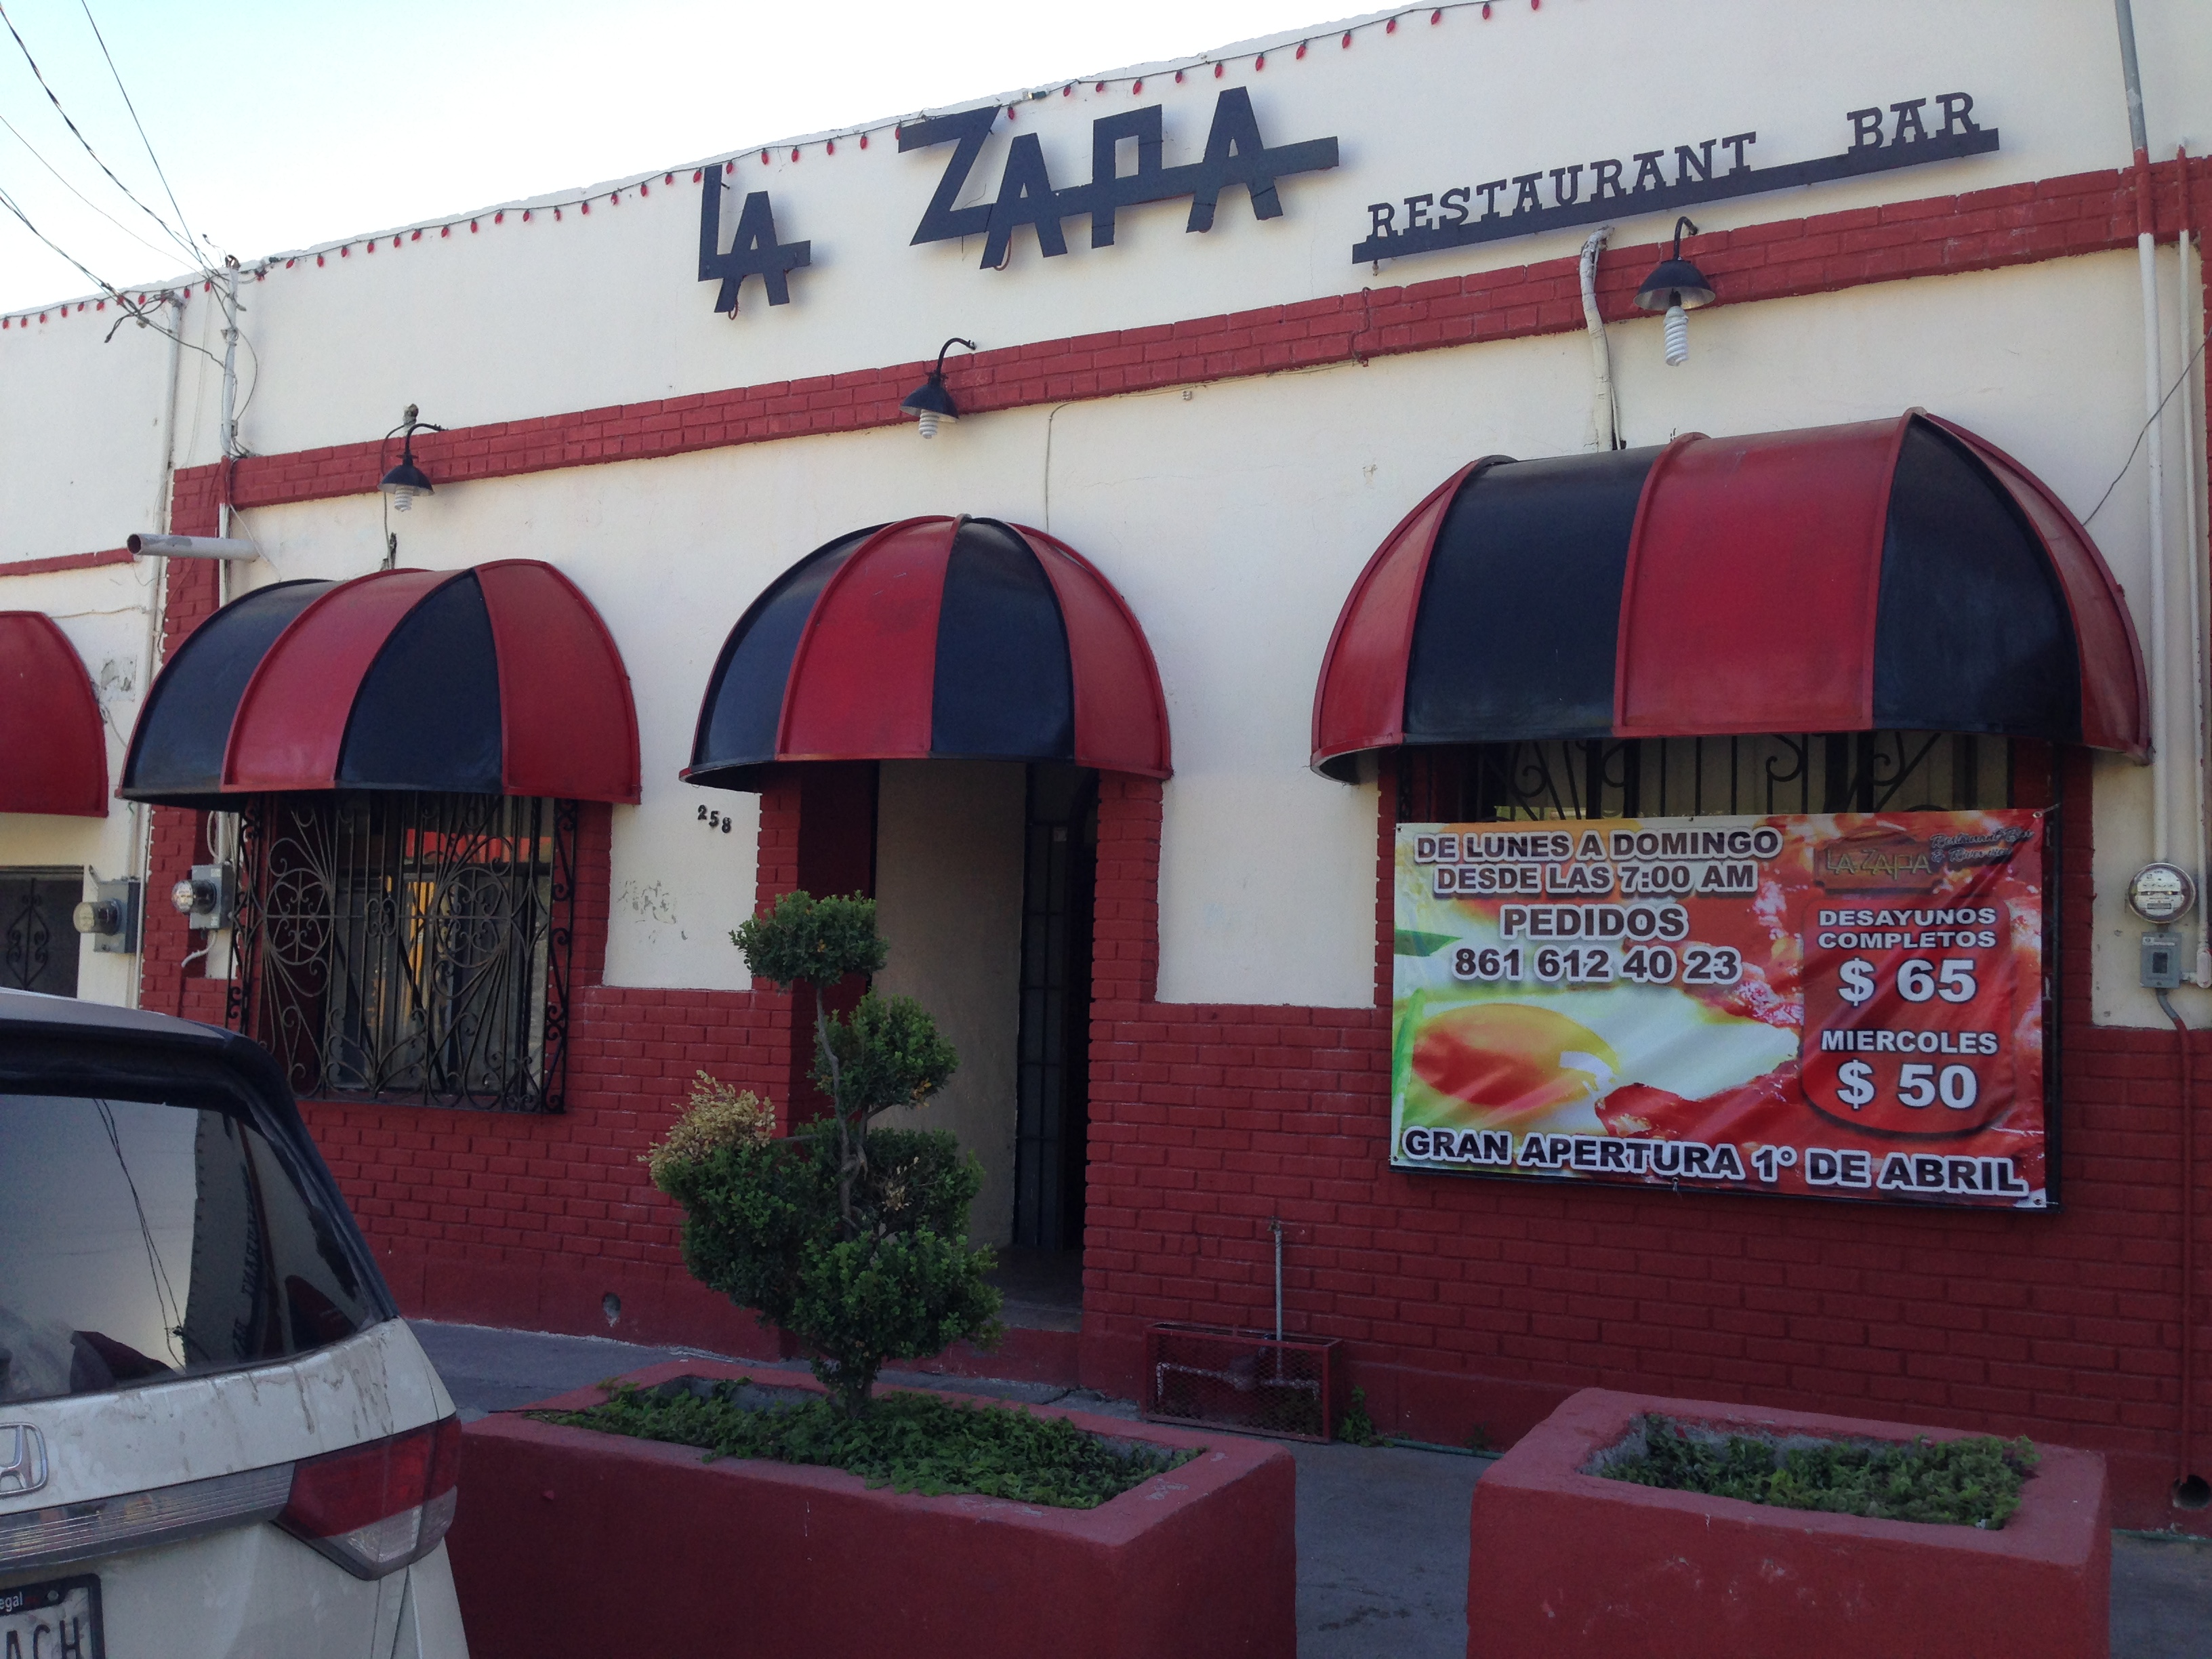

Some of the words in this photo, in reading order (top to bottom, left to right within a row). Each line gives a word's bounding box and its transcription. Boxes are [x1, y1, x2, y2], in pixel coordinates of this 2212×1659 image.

[1365, 131, 1757, 244] RESTAURANT
[1847, 91, 1986, 156] BAR
[698, 164, 811, 312] LA
[697, 804, 732, 834] 258
[1416, 836, 1457, 859] DE
[1466, 834, 1571, 858] LUNES
[1579, 834, 1604, 857] A
[1613, 830, 1780, 856] DOMINGO
[1437, 867, 1539, 890] DESDE
[1549, 866, 1610, 889] LAS
[1620, 865, 1691, 889] 7:00
[1700, 864, 1755, 888] AM
[1827, 849, 1856, 875] LA
[1503, 907, 1685, 938] PEDIDOS
[1818, 907, 1996, 926] DESAYUNOS
[1818, 930, 1996, 949] COMPLETOS
[1454, 947, 1521, 977] 861
[1537, 948, 1610, 979] 612
[1622, 949, 1674, 979] 40
[1685, 950, 1738, 981] 23
[1838, 958, 1875, 1006] $
[1897, 959, 1977, 1003] 65
[1820, 1029, 1999, 1054] MIERCOLES
[1837, 1059, 1875, 1109] $
[1897, 1063, 1978, 1109] 50
[1404, 1129, 1509, 1162] GRAN
[1520, 1135, 1743, 1177] APERTURA
[1809, 1151, 1868, 1185] DE
[1880, 1155, 2025, 1192] ABRIL
